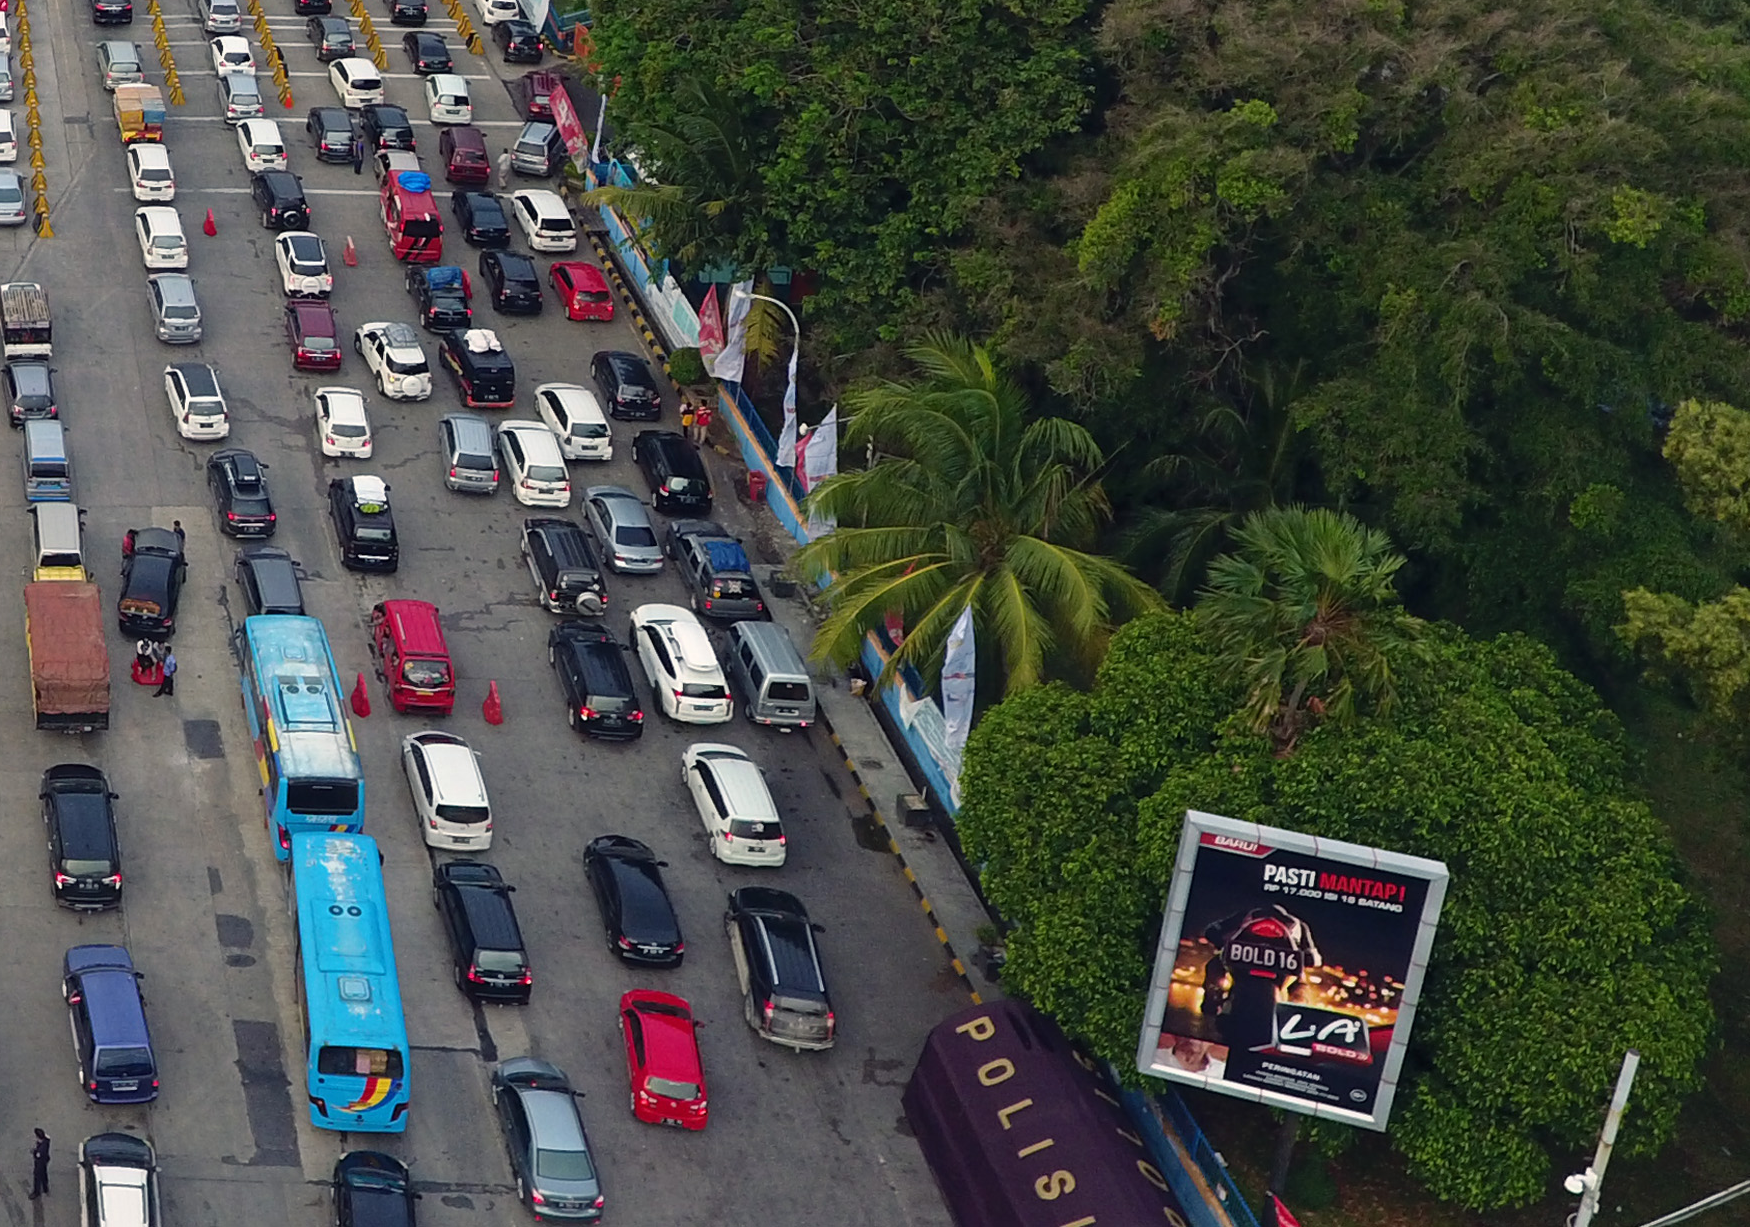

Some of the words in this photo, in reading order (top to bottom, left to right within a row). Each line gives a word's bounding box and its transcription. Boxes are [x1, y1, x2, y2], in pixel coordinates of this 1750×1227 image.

[1263, 864, 1316, 888] PASTI
[1358, 898, 1403, 913] BATANG
[1230, 944, 1276, 966] BOLD
[1279, 951, 1298, 970] 16
[1315, 1044, 1357, 1058] BOLD
